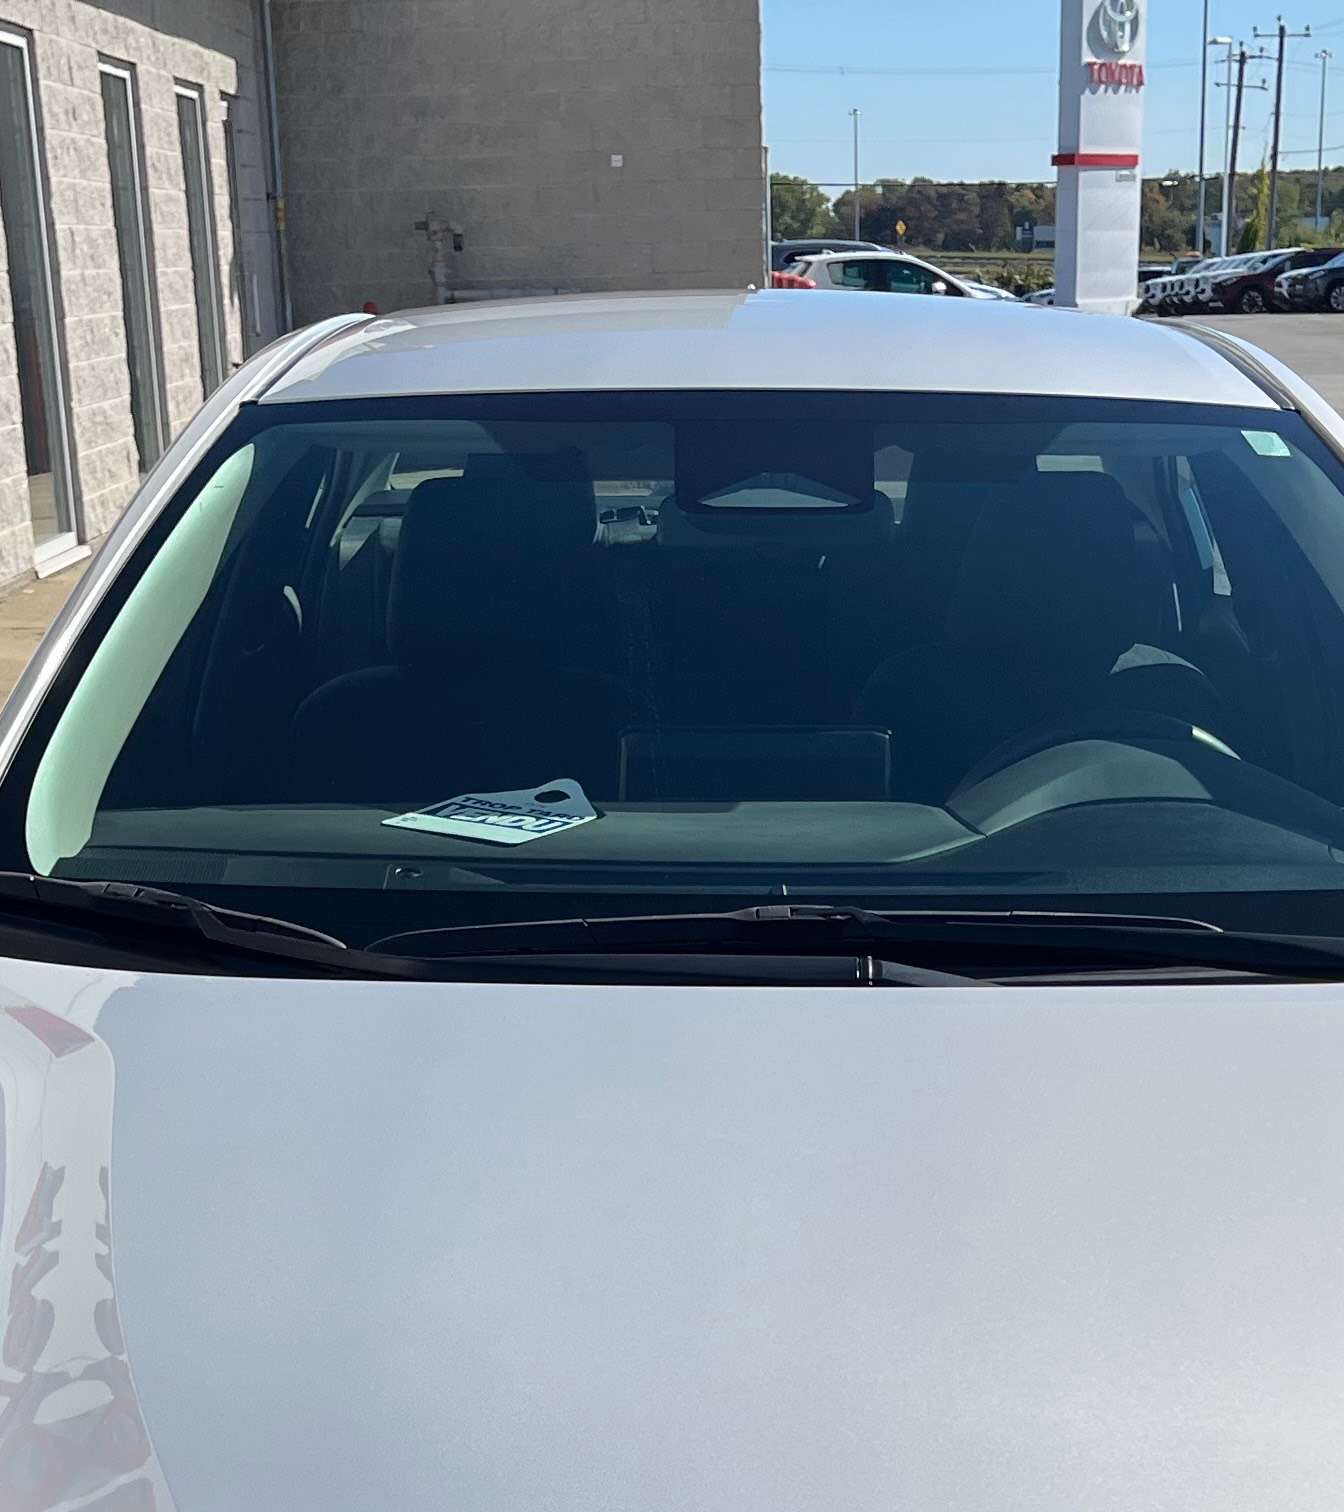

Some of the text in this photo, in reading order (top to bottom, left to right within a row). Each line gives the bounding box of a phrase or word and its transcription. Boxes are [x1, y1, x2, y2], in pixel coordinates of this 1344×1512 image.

[1087, 63, 1144, 87] TOYOTA
[435, 803, 563, 832] VENDU
[461, 796, 522, 811] TROP
[527, 808, 584, 821] TARD
